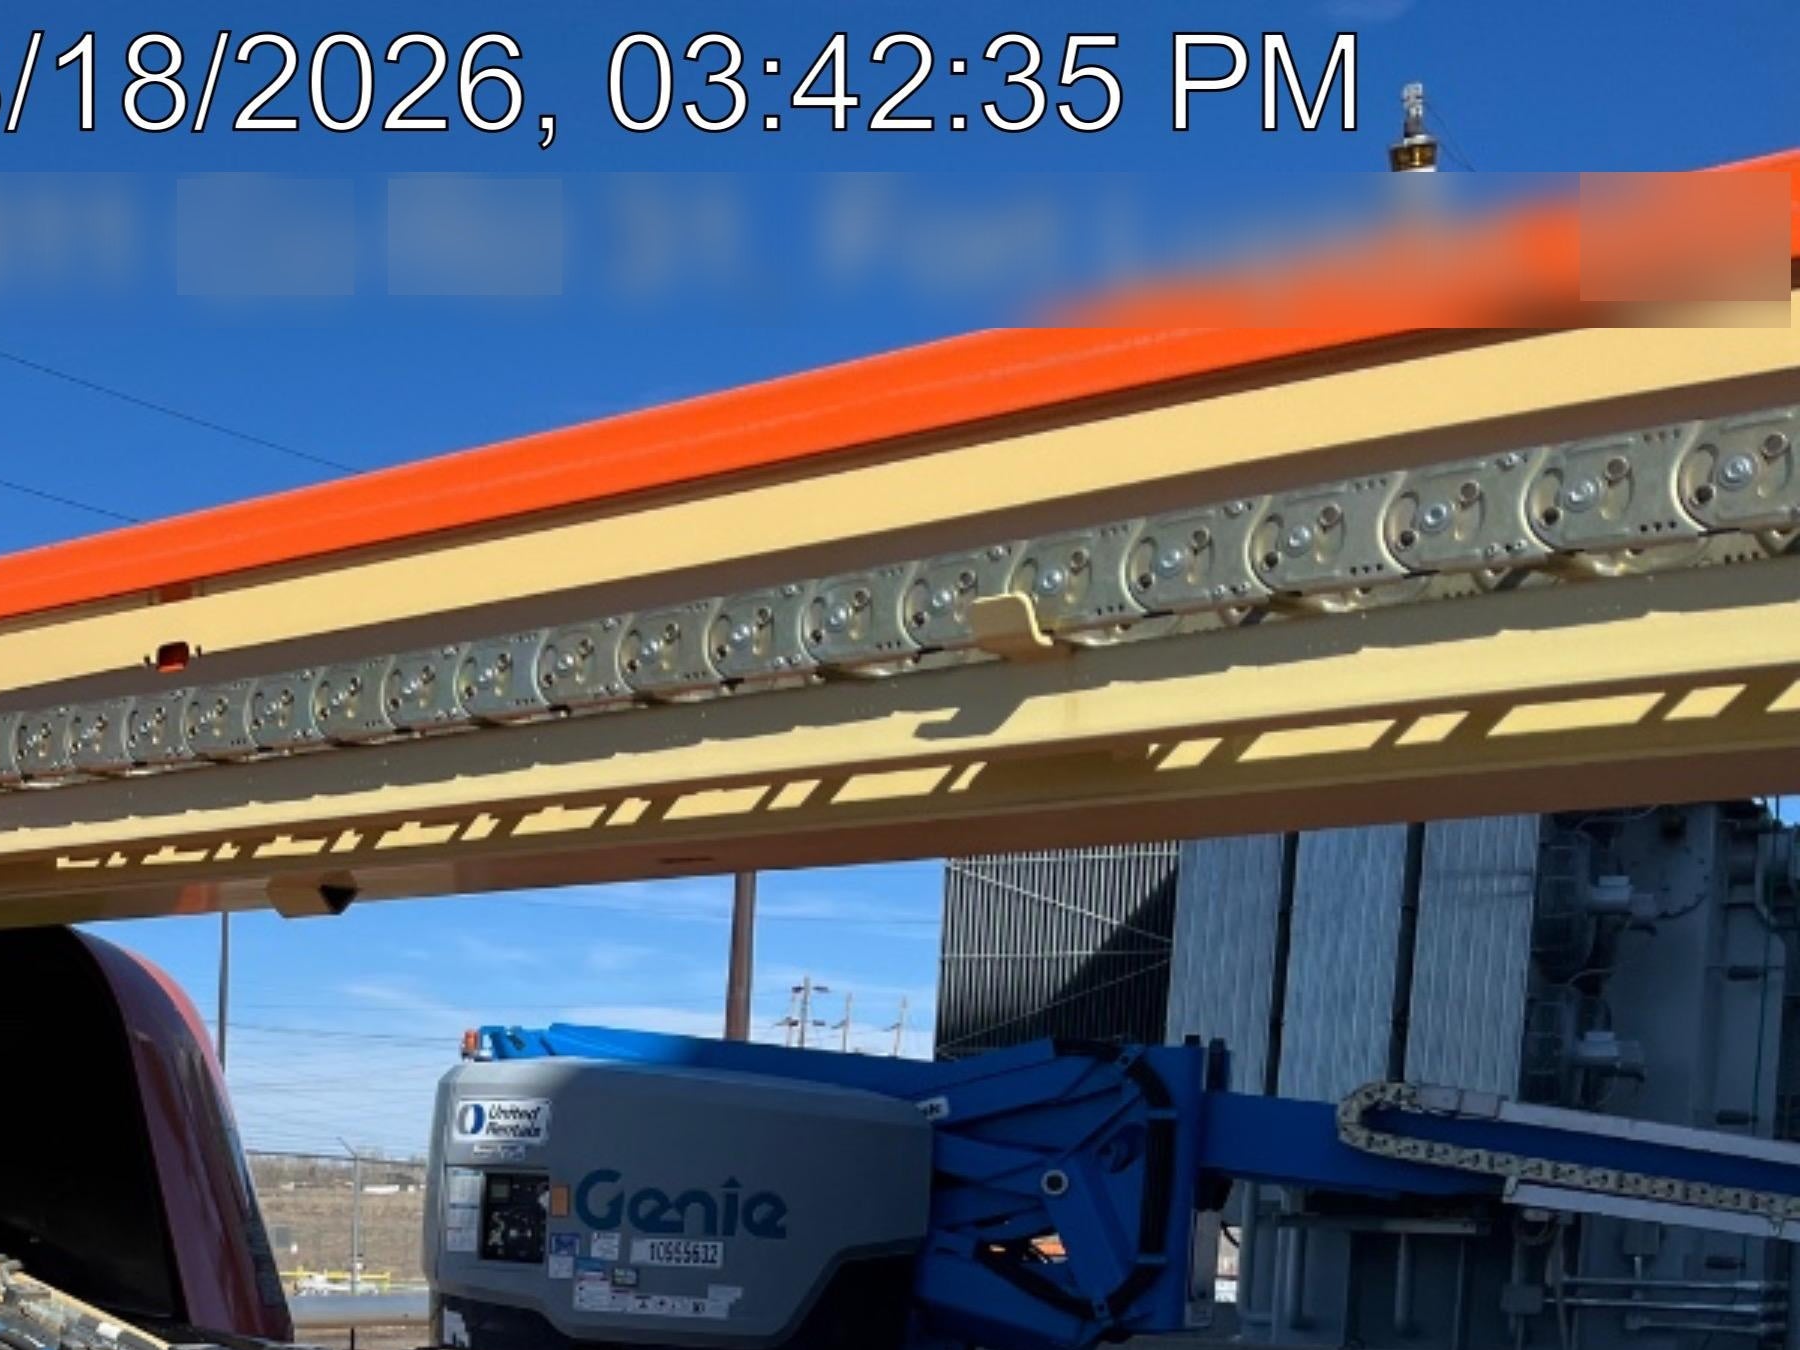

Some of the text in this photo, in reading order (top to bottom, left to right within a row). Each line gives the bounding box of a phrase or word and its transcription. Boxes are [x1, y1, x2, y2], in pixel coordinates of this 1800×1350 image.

[488, 1104, 541, 1120] United
[486, 1121, 541, 1138] Rentals
[575, 1169, 788, 1239] Genie
